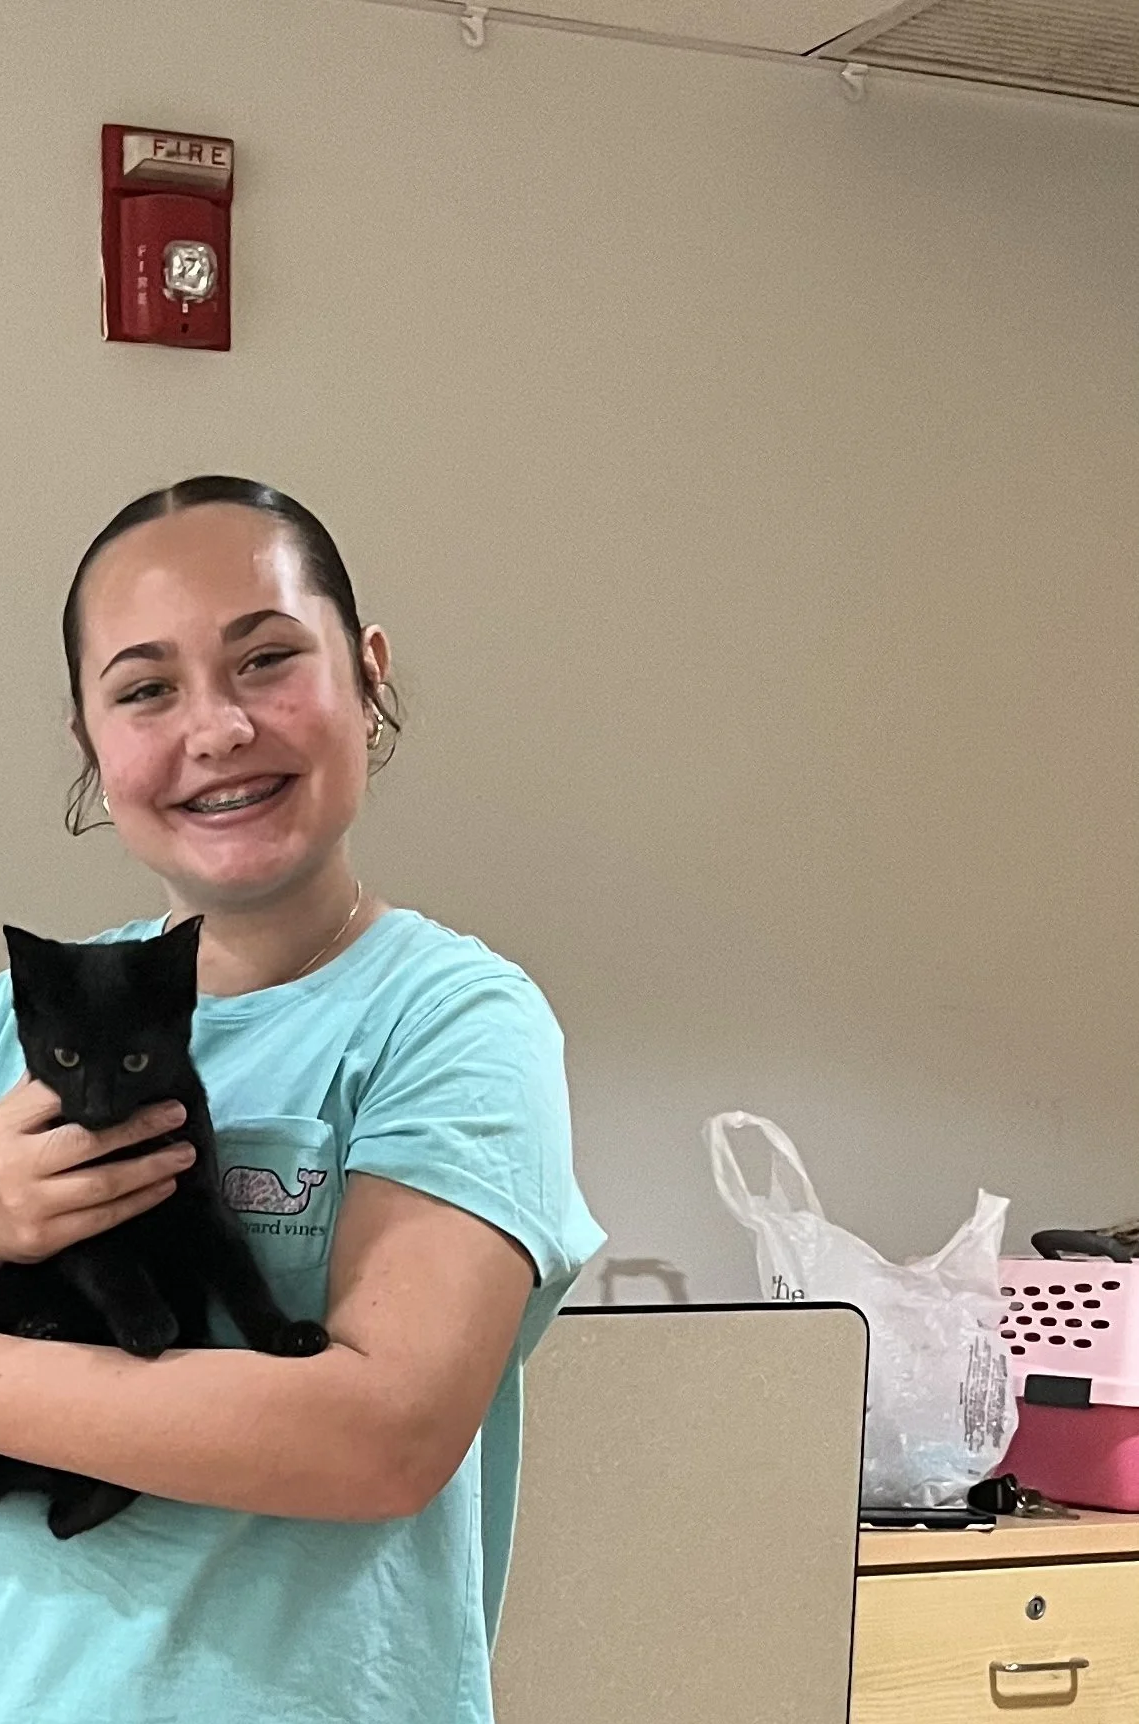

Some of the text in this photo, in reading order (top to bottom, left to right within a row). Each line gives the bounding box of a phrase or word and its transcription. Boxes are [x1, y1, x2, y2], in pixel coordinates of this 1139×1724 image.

[152, 138, 226, 166] FIRE
[241, 1219, 326, 1237] yard vines
